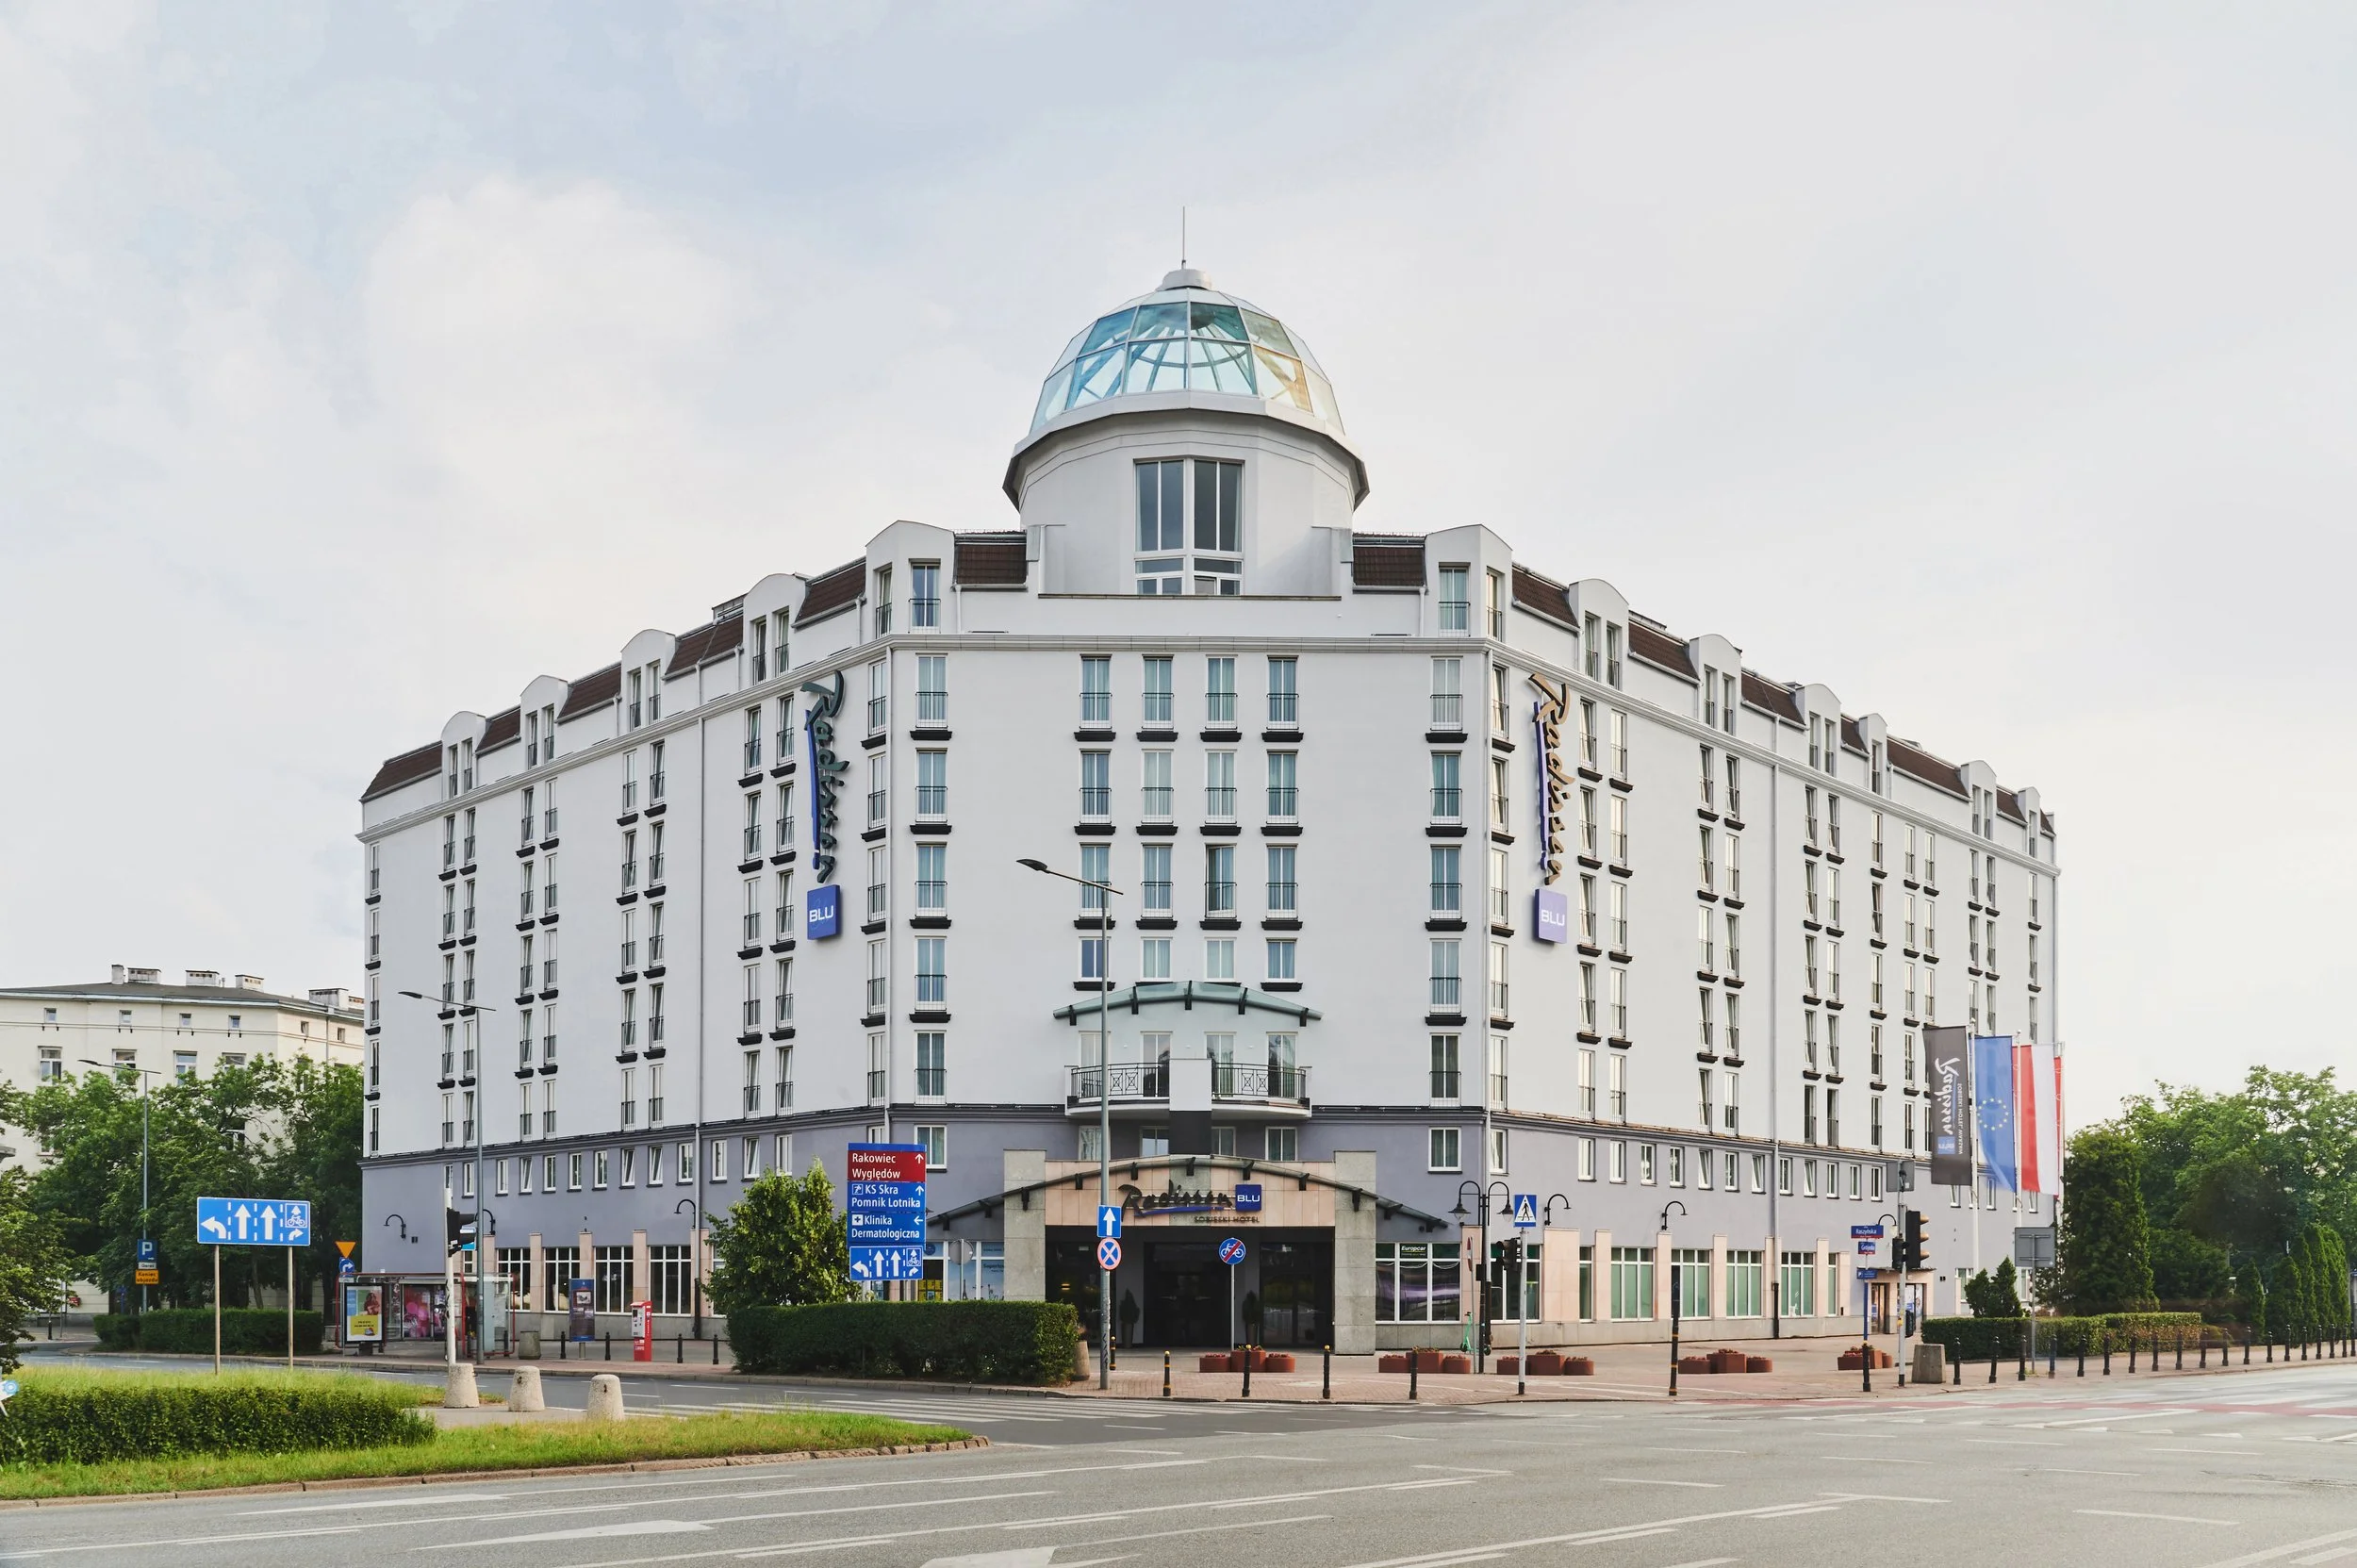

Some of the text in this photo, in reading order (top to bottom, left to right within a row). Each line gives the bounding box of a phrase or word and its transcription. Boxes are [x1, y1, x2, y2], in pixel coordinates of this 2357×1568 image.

[799, 670, 849, 883] Radisson
[1528, 672, 1575, 885] Radisson
[809, 904, 834, 923] BLU
[1541, 908, 1565, 927] BLU
[852, 1152, 897, 1164] Rakowiec
[851, 1168, 901, 1180] Wyględów
[865, 1184, 898, 1195] KS Skra
[851, 1197, 921, 1208] Pomnik Lotnika
[1118, 1179, 1233, 1223] Radisson
[864, 1213, 893, 1225] Klinika
[851, 1228, 920, 1241] Dermatologiczna
